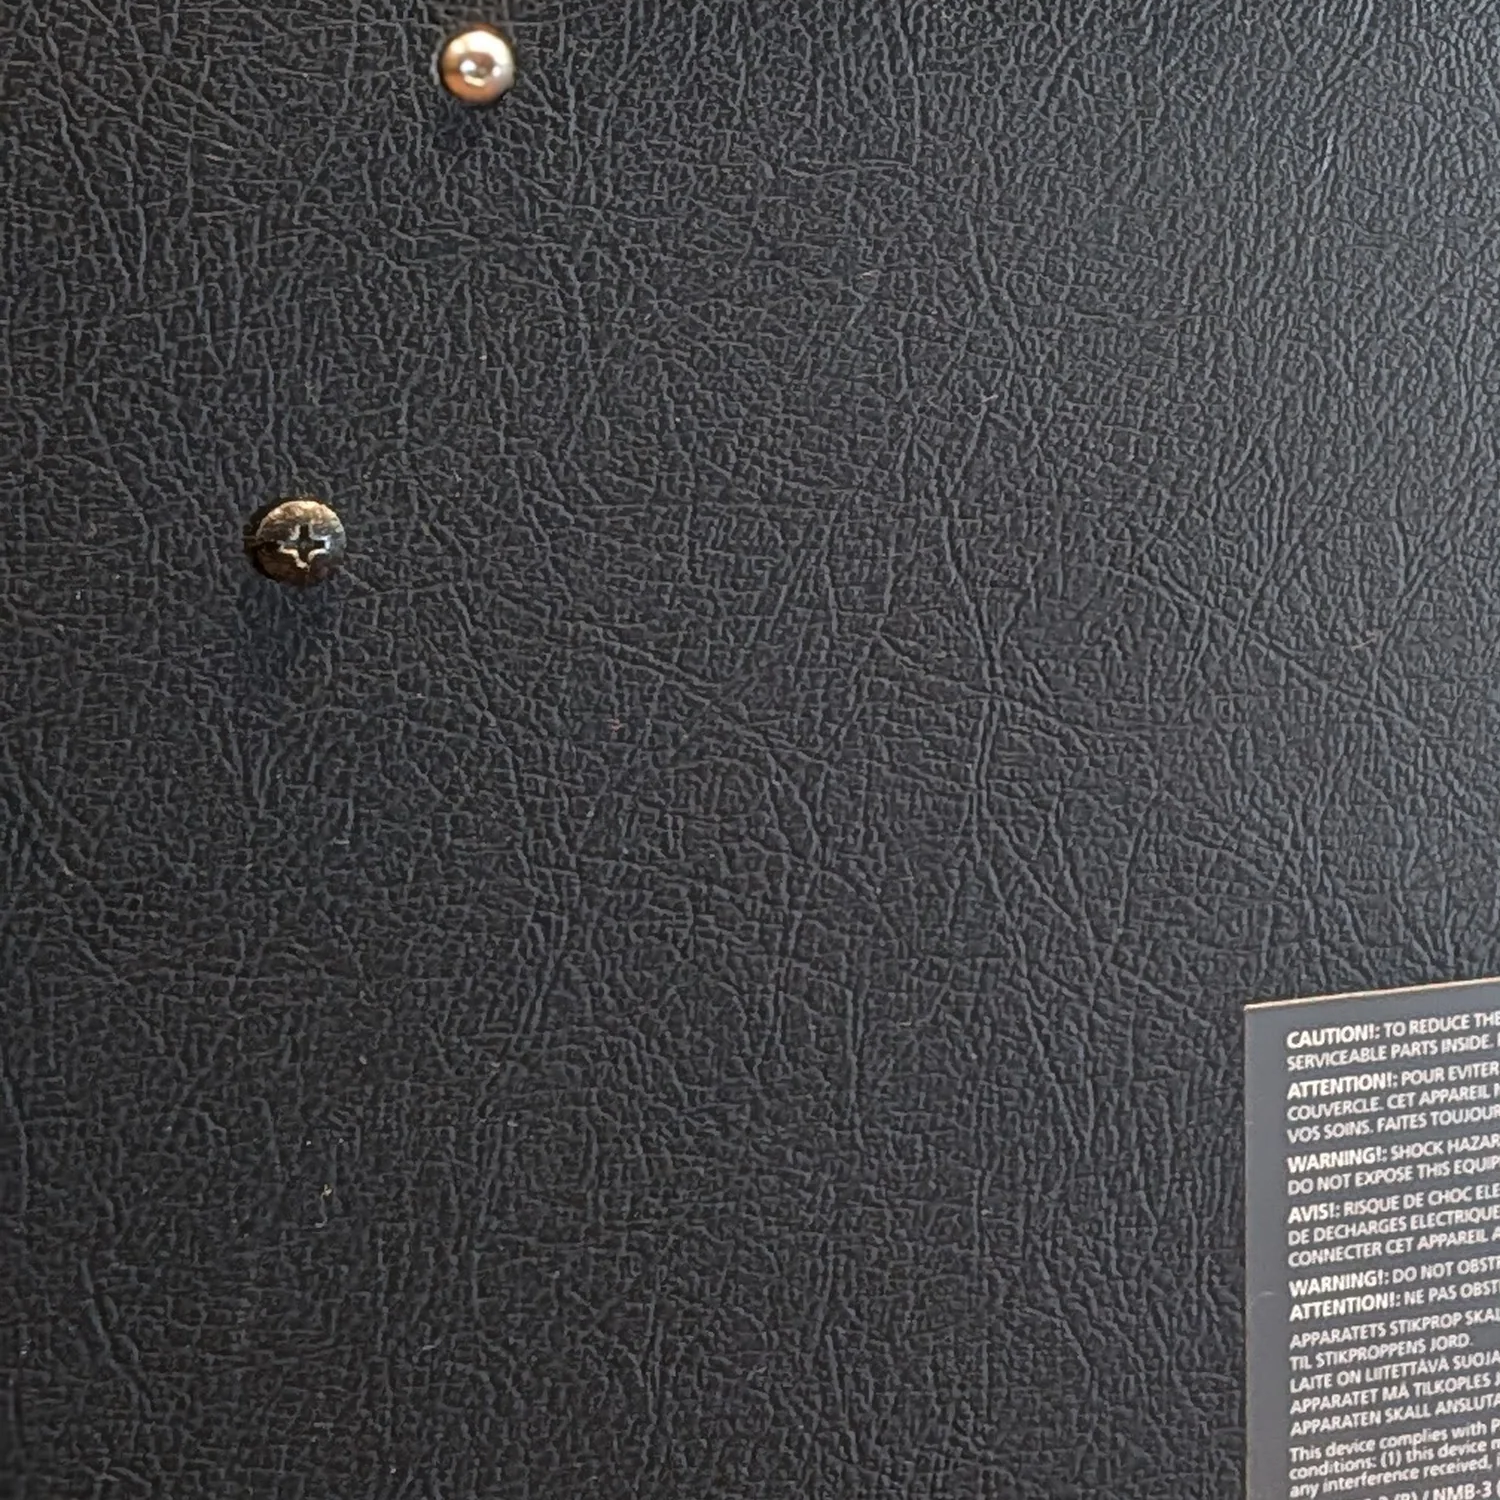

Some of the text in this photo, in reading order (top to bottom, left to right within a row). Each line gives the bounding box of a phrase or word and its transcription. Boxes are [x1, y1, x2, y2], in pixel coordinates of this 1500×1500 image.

[1286, 1023, 1380, 1049] CAUTION!:
[1383, 1021, 1406, 1037] TO
[1409, 1013, 1470, 1034] REDUCE
[1286, 1045, 1387, 1071] SERVICEABLE
[1390, 1039, 1438, 1059] PARTS
[1441, 1033, 1493, 1053] INSIDE.
[1286, 1145, 1387, 1173] WARNING!:
[1390, 1140, 1444, 1160] SHOCK
[1287, 1178, 1313, 1195] DO
[1317, 1172, 1351, 1191] NOT
[1355, 1165, 1412, 1187] EXPOSE
[1416, 1160, 1450, 1179] THIS
[1287, 1241, 1382, 1267] CONNECTER
[1385, 1236, 1414, 1255] CET
[1416, 1228, 1489, 1250] APPAREIL
[1288, 1268, 1389, 1297] WARNING!:
[1392, 1266, 1417, 1283] DO
[1420, 1261, 1454, 1279] NOT
[1289, 1291, 1400, 1321] ATTENTION!:
[1403, 1288, 1424, 1305] NE
[1428, 1284, 1457, 1302] PAS
[1289, 1410, 1381, 1436] APPARATEN
[1384, 1403, 1431, 1423] SKALL
